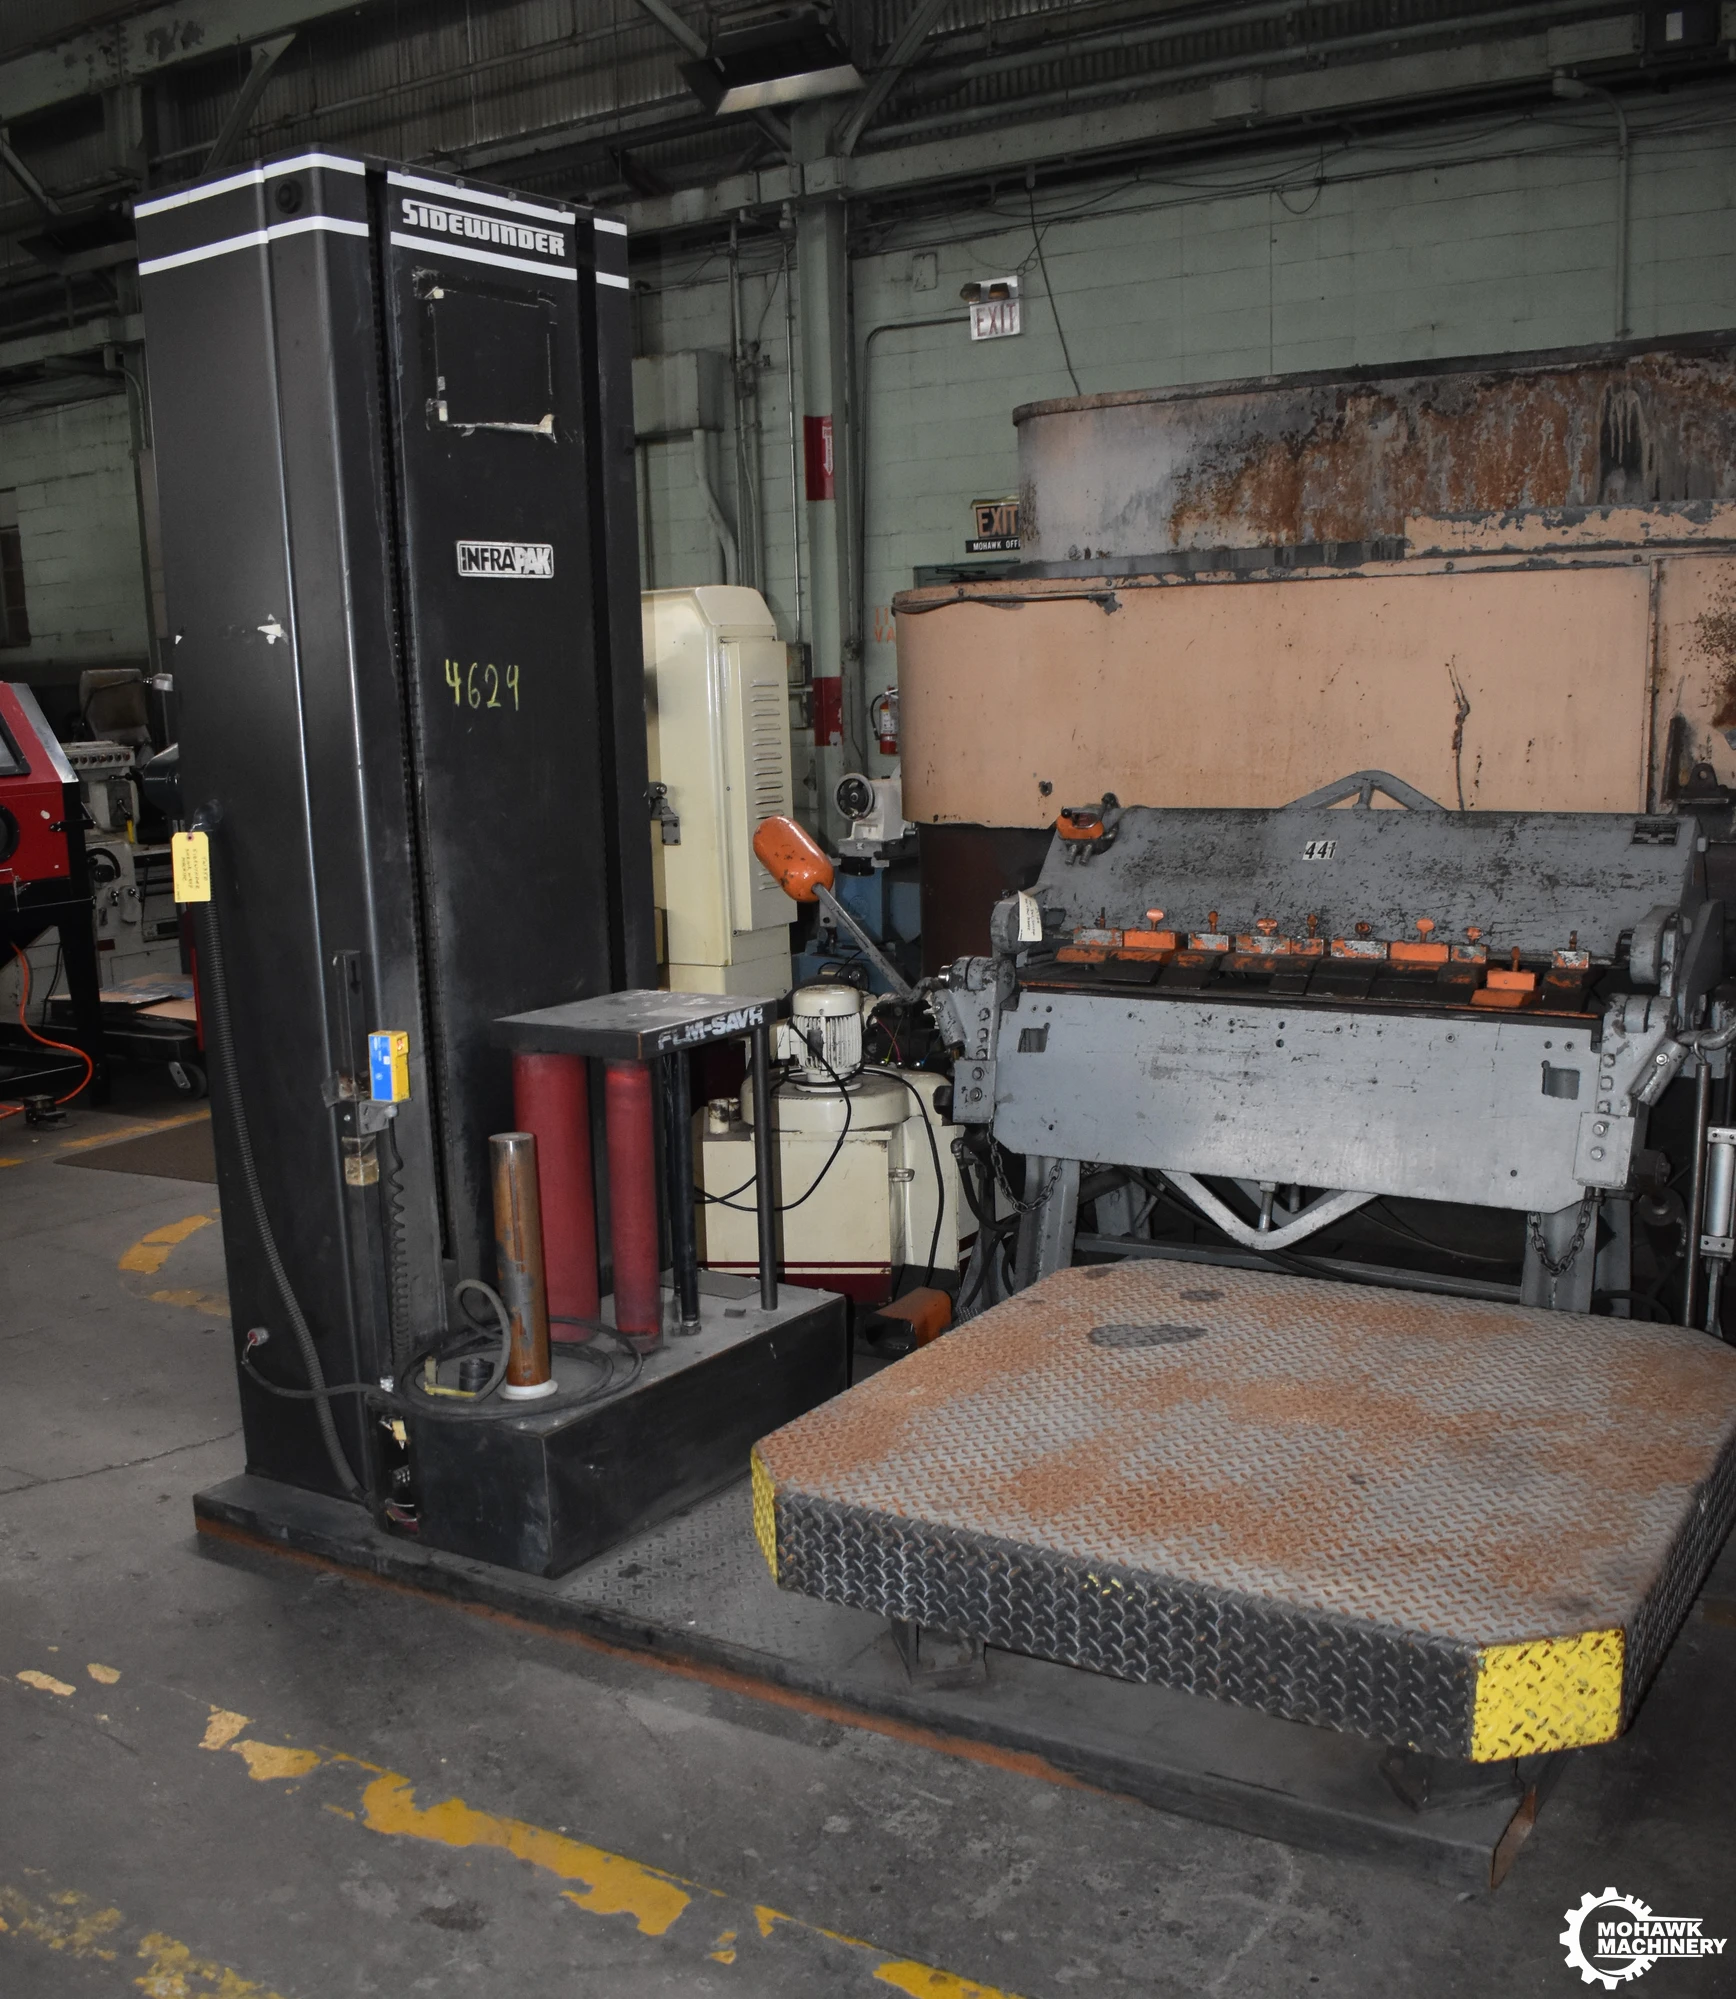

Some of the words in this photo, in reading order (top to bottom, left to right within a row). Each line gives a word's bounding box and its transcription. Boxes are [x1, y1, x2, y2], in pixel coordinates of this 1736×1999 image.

[401, 198, 566, 257] SIDEWINDER
[976, 303, 1016, 337] EXIT
[976, 505, 1018, 537] EXIT
[461, 546, 551, 575] INFRAPAK
[972, 541, 1002, 551] MOHAWK
[445, 658, 520, 711] 4624
[1304, 841, 1337, 859] 441
